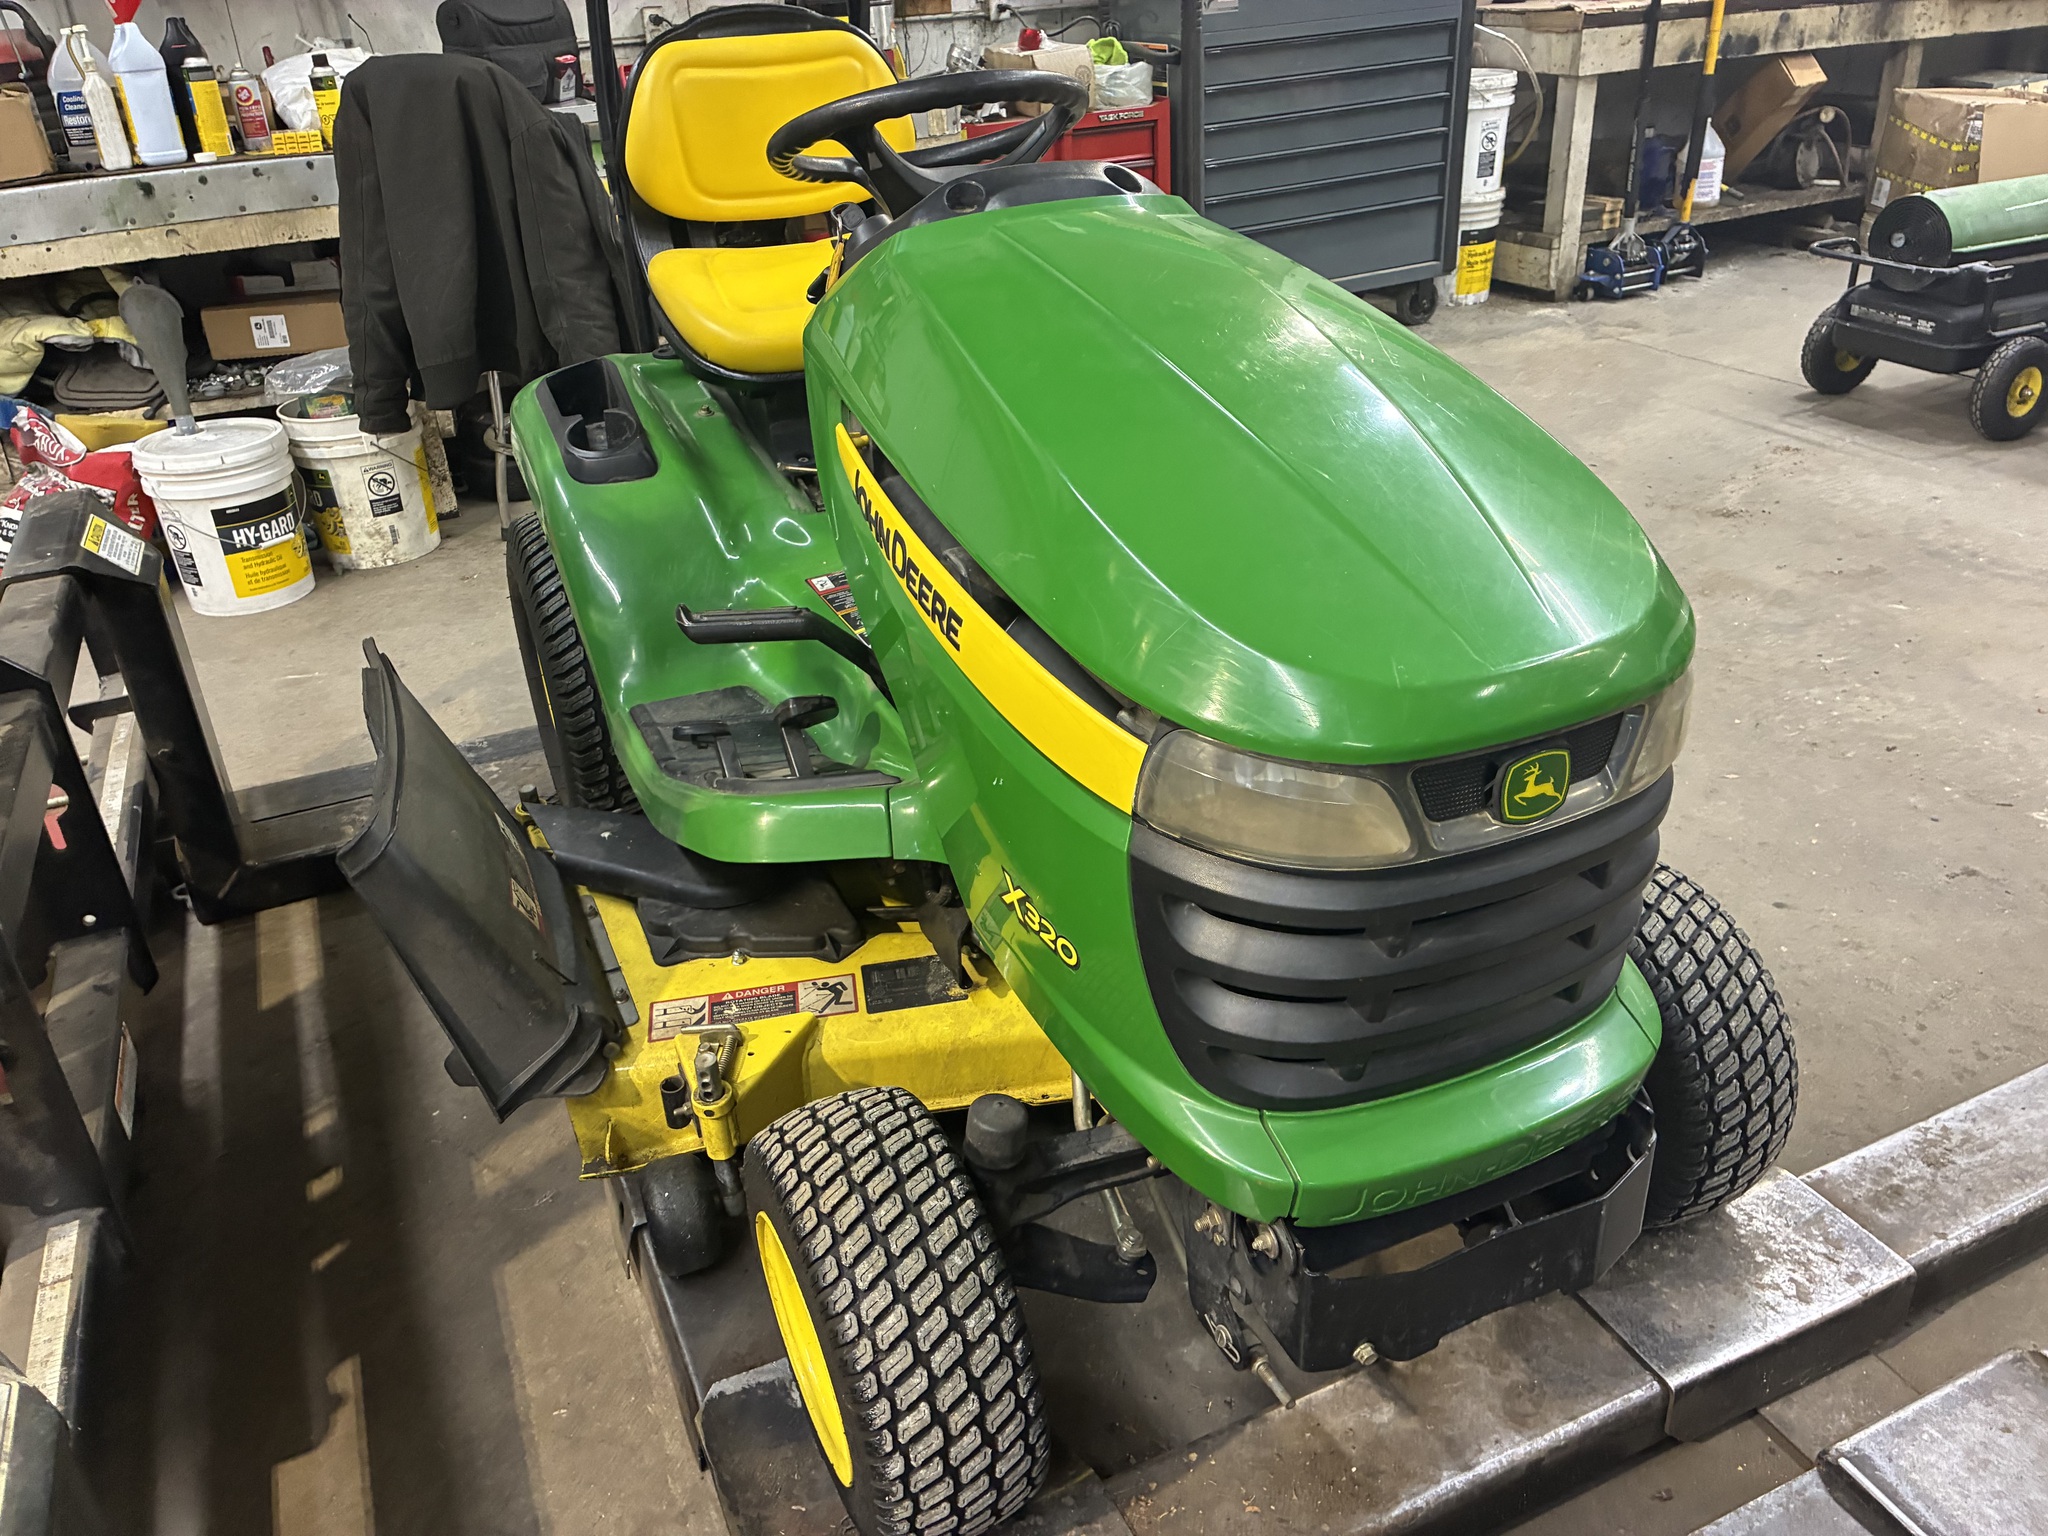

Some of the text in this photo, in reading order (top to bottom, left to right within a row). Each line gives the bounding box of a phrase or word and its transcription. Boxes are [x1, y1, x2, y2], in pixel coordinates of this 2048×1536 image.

[62, 95, 84, 103] Cooling
[1099, 111, 1144, 122] TASK FORCE
[368, 462, 392, 471] WARNING
[231, 511, 296, 548] HY-GARD
[241, 552, 274, 563] Transmission
[254, 557, 276, 568] Hydraulic
[853, 469, 892, 561] JOHN
[890, 528, 963, 652] DEERE
[245, 563, 287, 579] Huile hydraulique
[261, 568, 291, 582] transmission
[1000, 864, 1080, 971] X320
[736, 984, 785, 998] DANGER
[1331, 1164, 1484, 1220] JOHN
